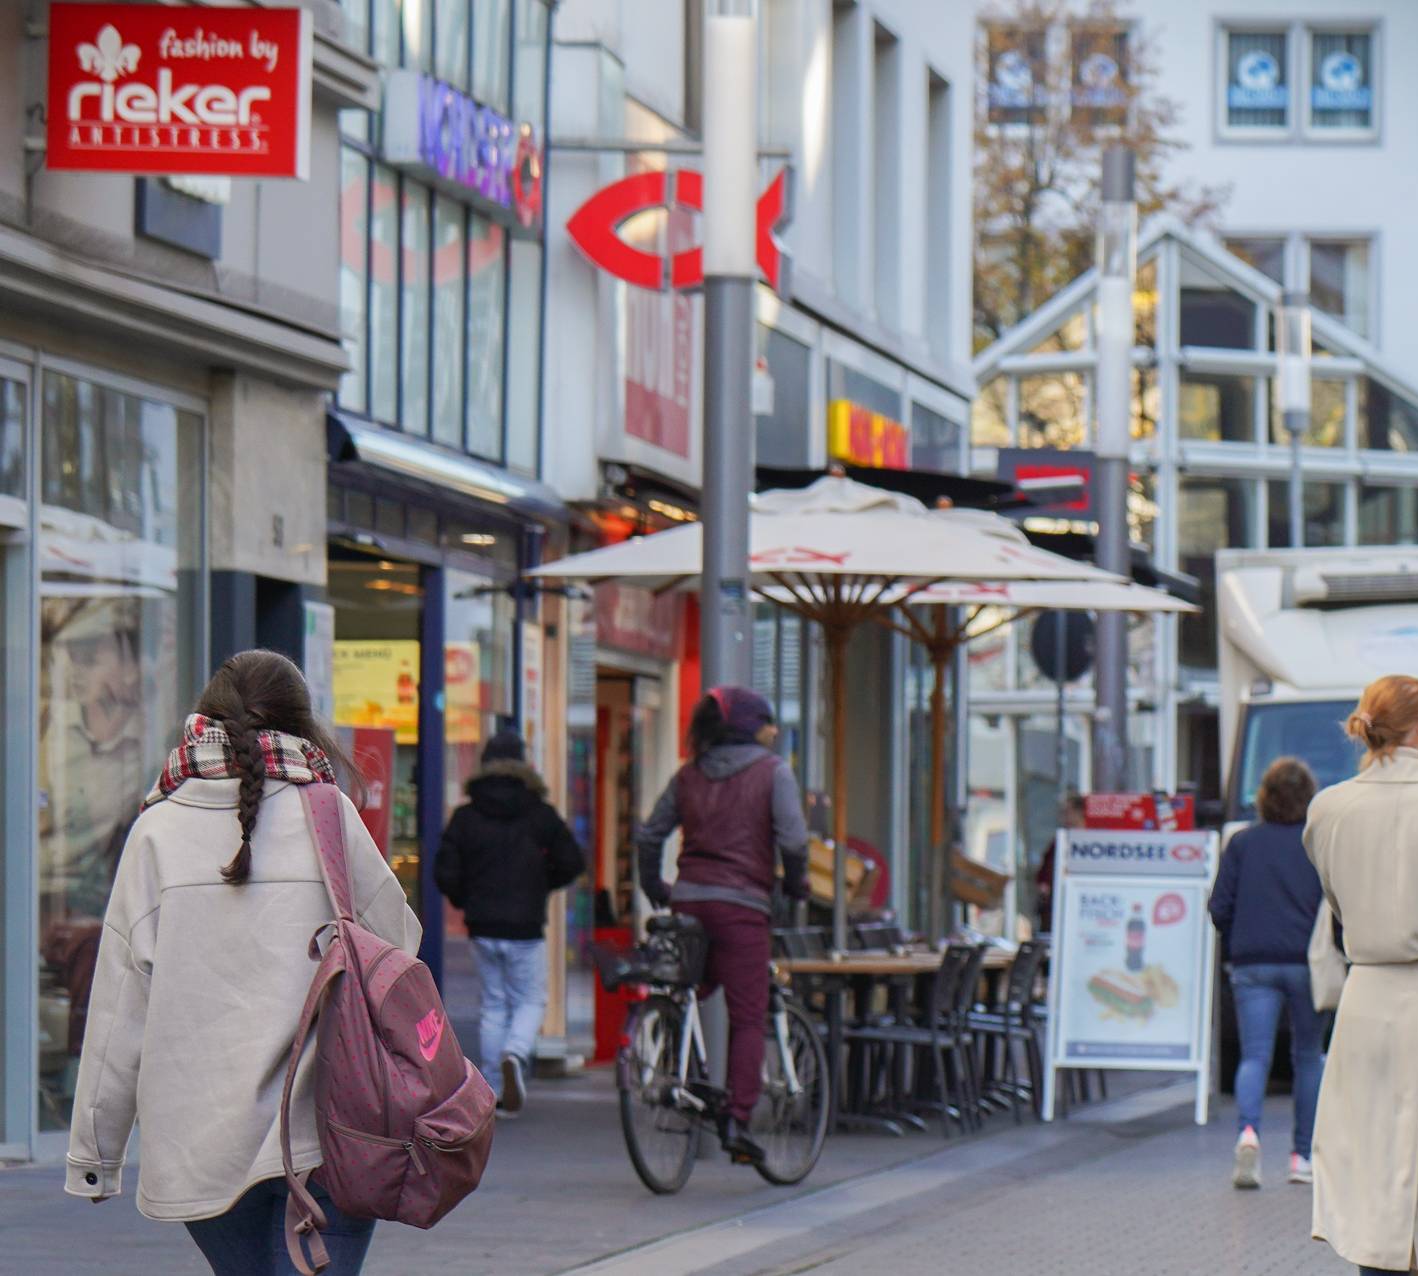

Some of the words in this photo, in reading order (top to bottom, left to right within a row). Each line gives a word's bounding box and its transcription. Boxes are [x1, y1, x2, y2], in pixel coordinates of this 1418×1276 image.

[160, 27, 243, 60] fashion
[250, 29, 279, 73] by
[68, 67, 272, 125] rieker
[69, 126, 262, 150] ANTISTRESS
[1071, 841, 1166, 861] NORDSEE
